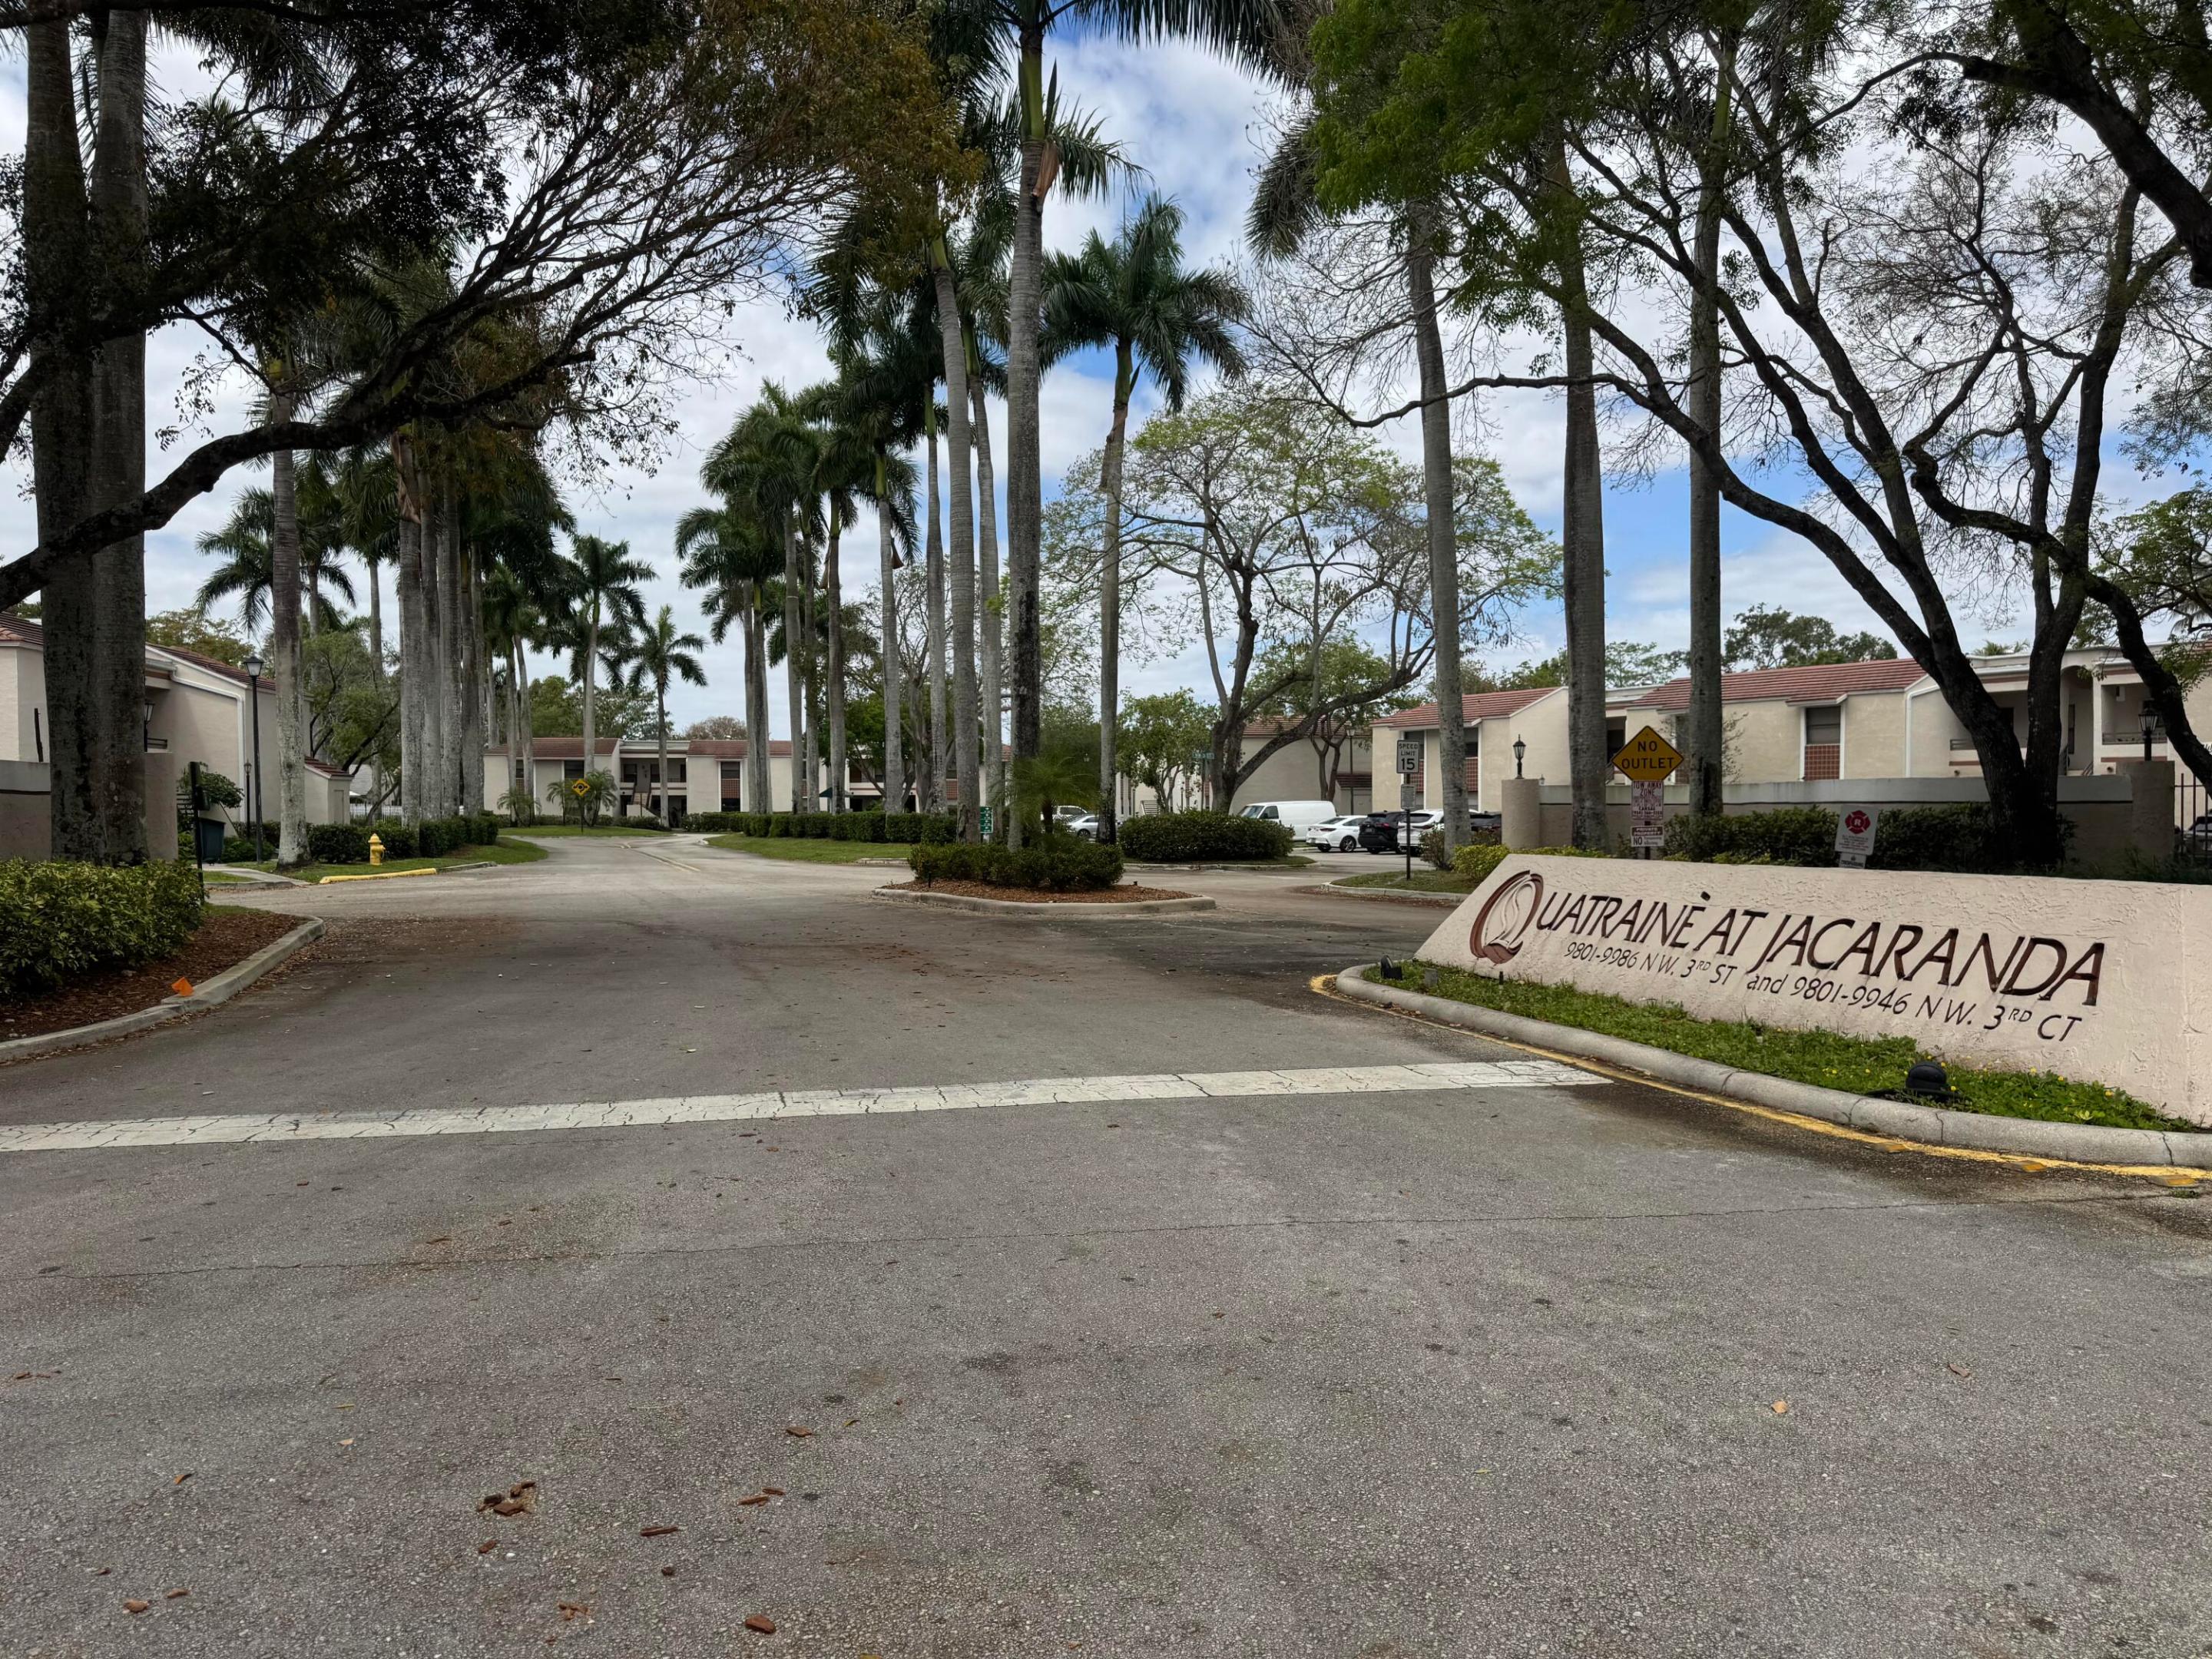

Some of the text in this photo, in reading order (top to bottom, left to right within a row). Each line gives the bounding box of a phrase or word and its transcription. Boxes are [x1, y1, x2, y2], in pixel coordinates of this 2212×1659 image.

[1637, 740, 1657, 752] NO
[1401, 758, 1415, 770] 15
[1621, 757, 1674, 769] OUTLET
[1633, 780, 1662, 789] TOW AWAY
[1641, 788, 1655, 796] ZONE
[1634, 837, 1643, 846] NO
[1693, 909, 1769, 956] AT
[1745, 914, 2105, 1007] JACARANDA
[1564, 942, 1641, 969] 9801-9986
[1710, 963, 1738, 985] ST
[1747, 974, 1789, 994] and
[1790, 975, 1912, 1015] 9801-9946
[2038, 1014, 2083, 1042] CT
